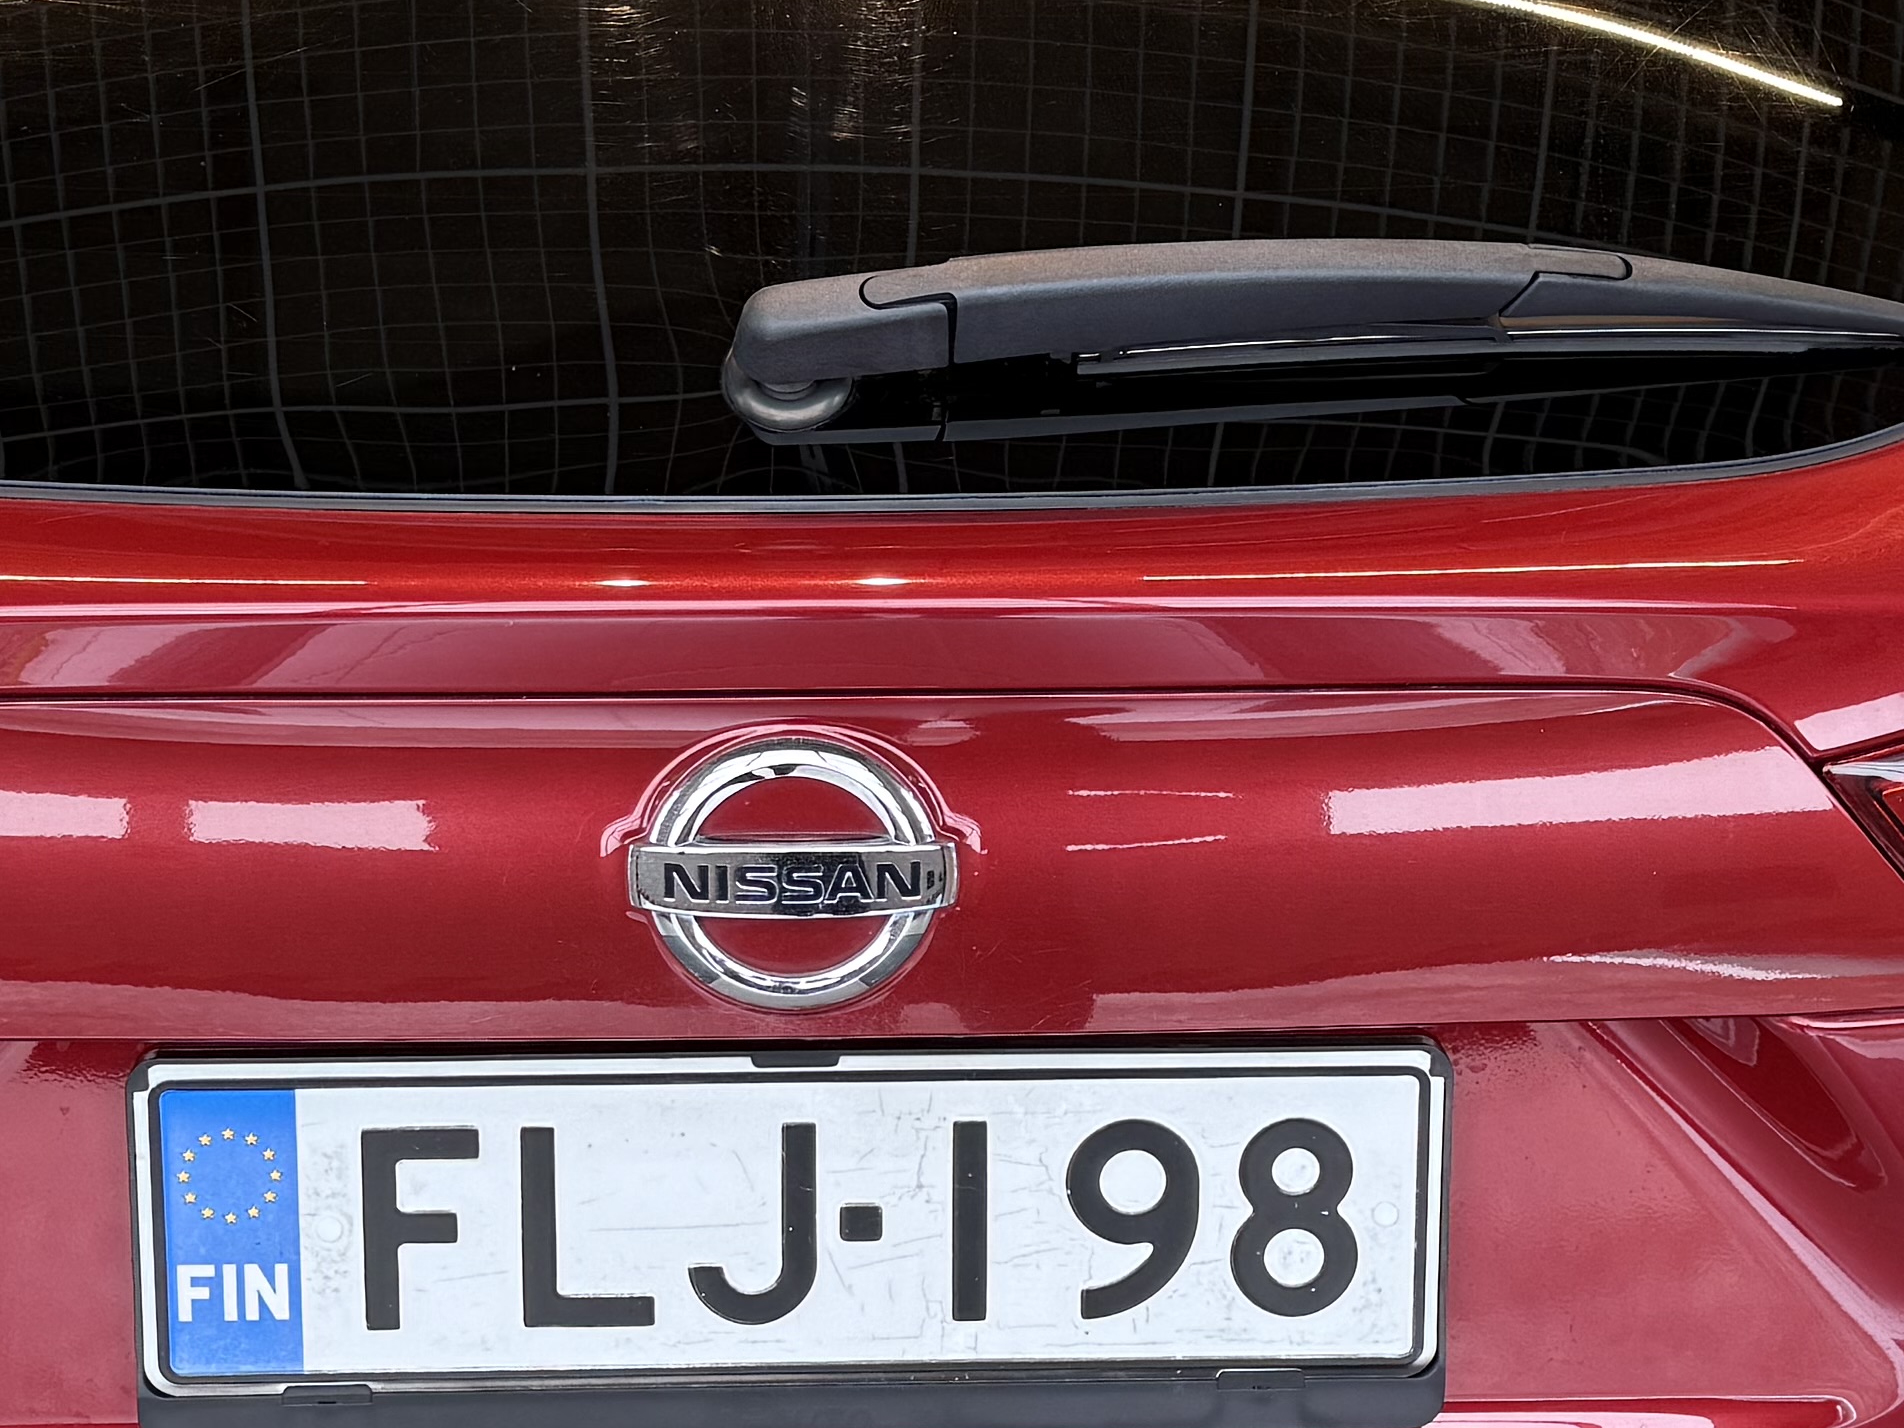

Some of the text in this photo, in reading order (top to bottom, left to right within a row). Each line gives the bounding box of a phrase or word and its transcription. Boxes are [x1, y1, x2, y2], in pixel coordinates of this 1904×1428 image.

[663, 860, 922, 905] NISSAN
[358, 1116, 1359, 1331] FLJ-198
[176, 1262, 291, 1324] FIN
